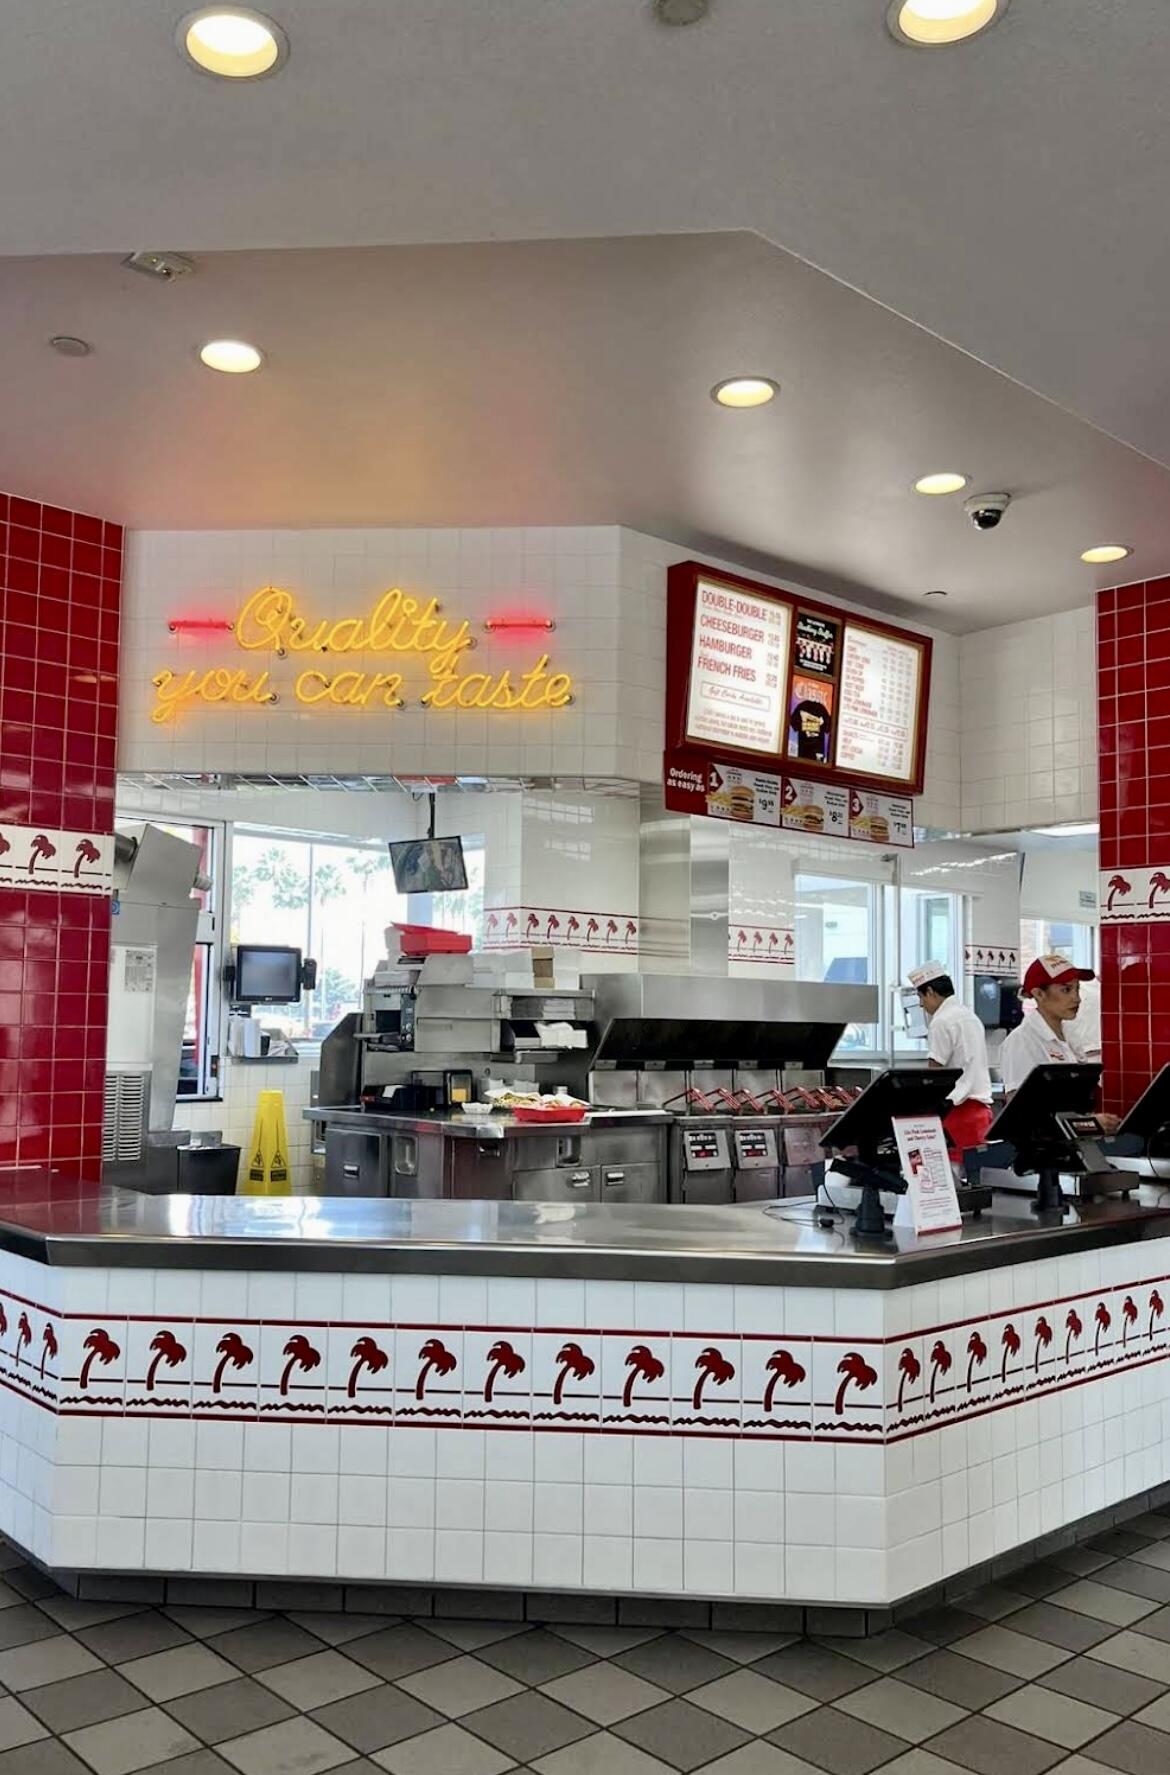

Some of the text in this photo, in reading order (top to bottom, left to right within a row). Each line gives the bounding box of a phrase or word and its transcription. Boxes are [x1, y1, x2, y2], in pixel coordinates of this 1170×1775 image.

[702, 590, 768, 621] DOUBLE-DOUBLE
[237, 586, 472, 674] Quality
[700, 615, 764, 643] CHEESEBURGER
[699, 634, 752, 659] HAMBURGER
[697, 656, 731, 675] FRENCH
[732, 665, 756, 682] FRIES
[152, 653, 572, 722] you can taste
[667, 778, 705, 793] as easy as
[669, 767, 703, 784] Ordering
[709, 771, 719, 788] 1
[784, 785, 794, 800] 2
[851, 797, 860, 813] 3
